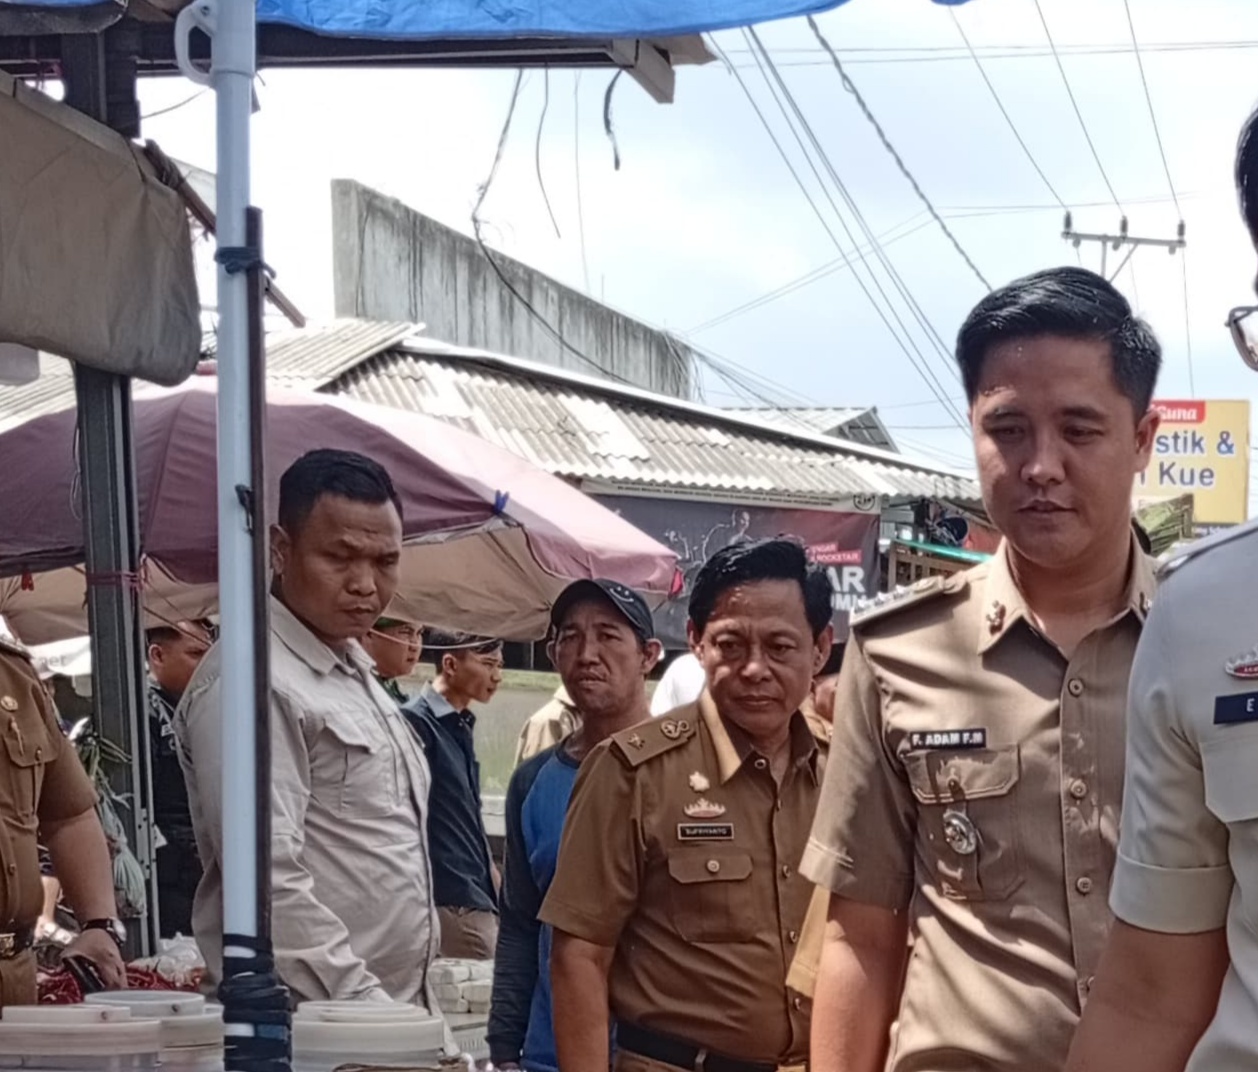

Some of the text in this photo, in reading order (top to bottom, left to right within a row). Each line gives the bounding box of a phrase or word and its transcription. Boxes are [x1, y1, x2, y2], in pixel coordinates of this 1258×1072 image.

[1155, 430, 1235, 454] stik &
[1159, 461, 1215, 486] Kue
[925, 732, 960, 746] ADAM
